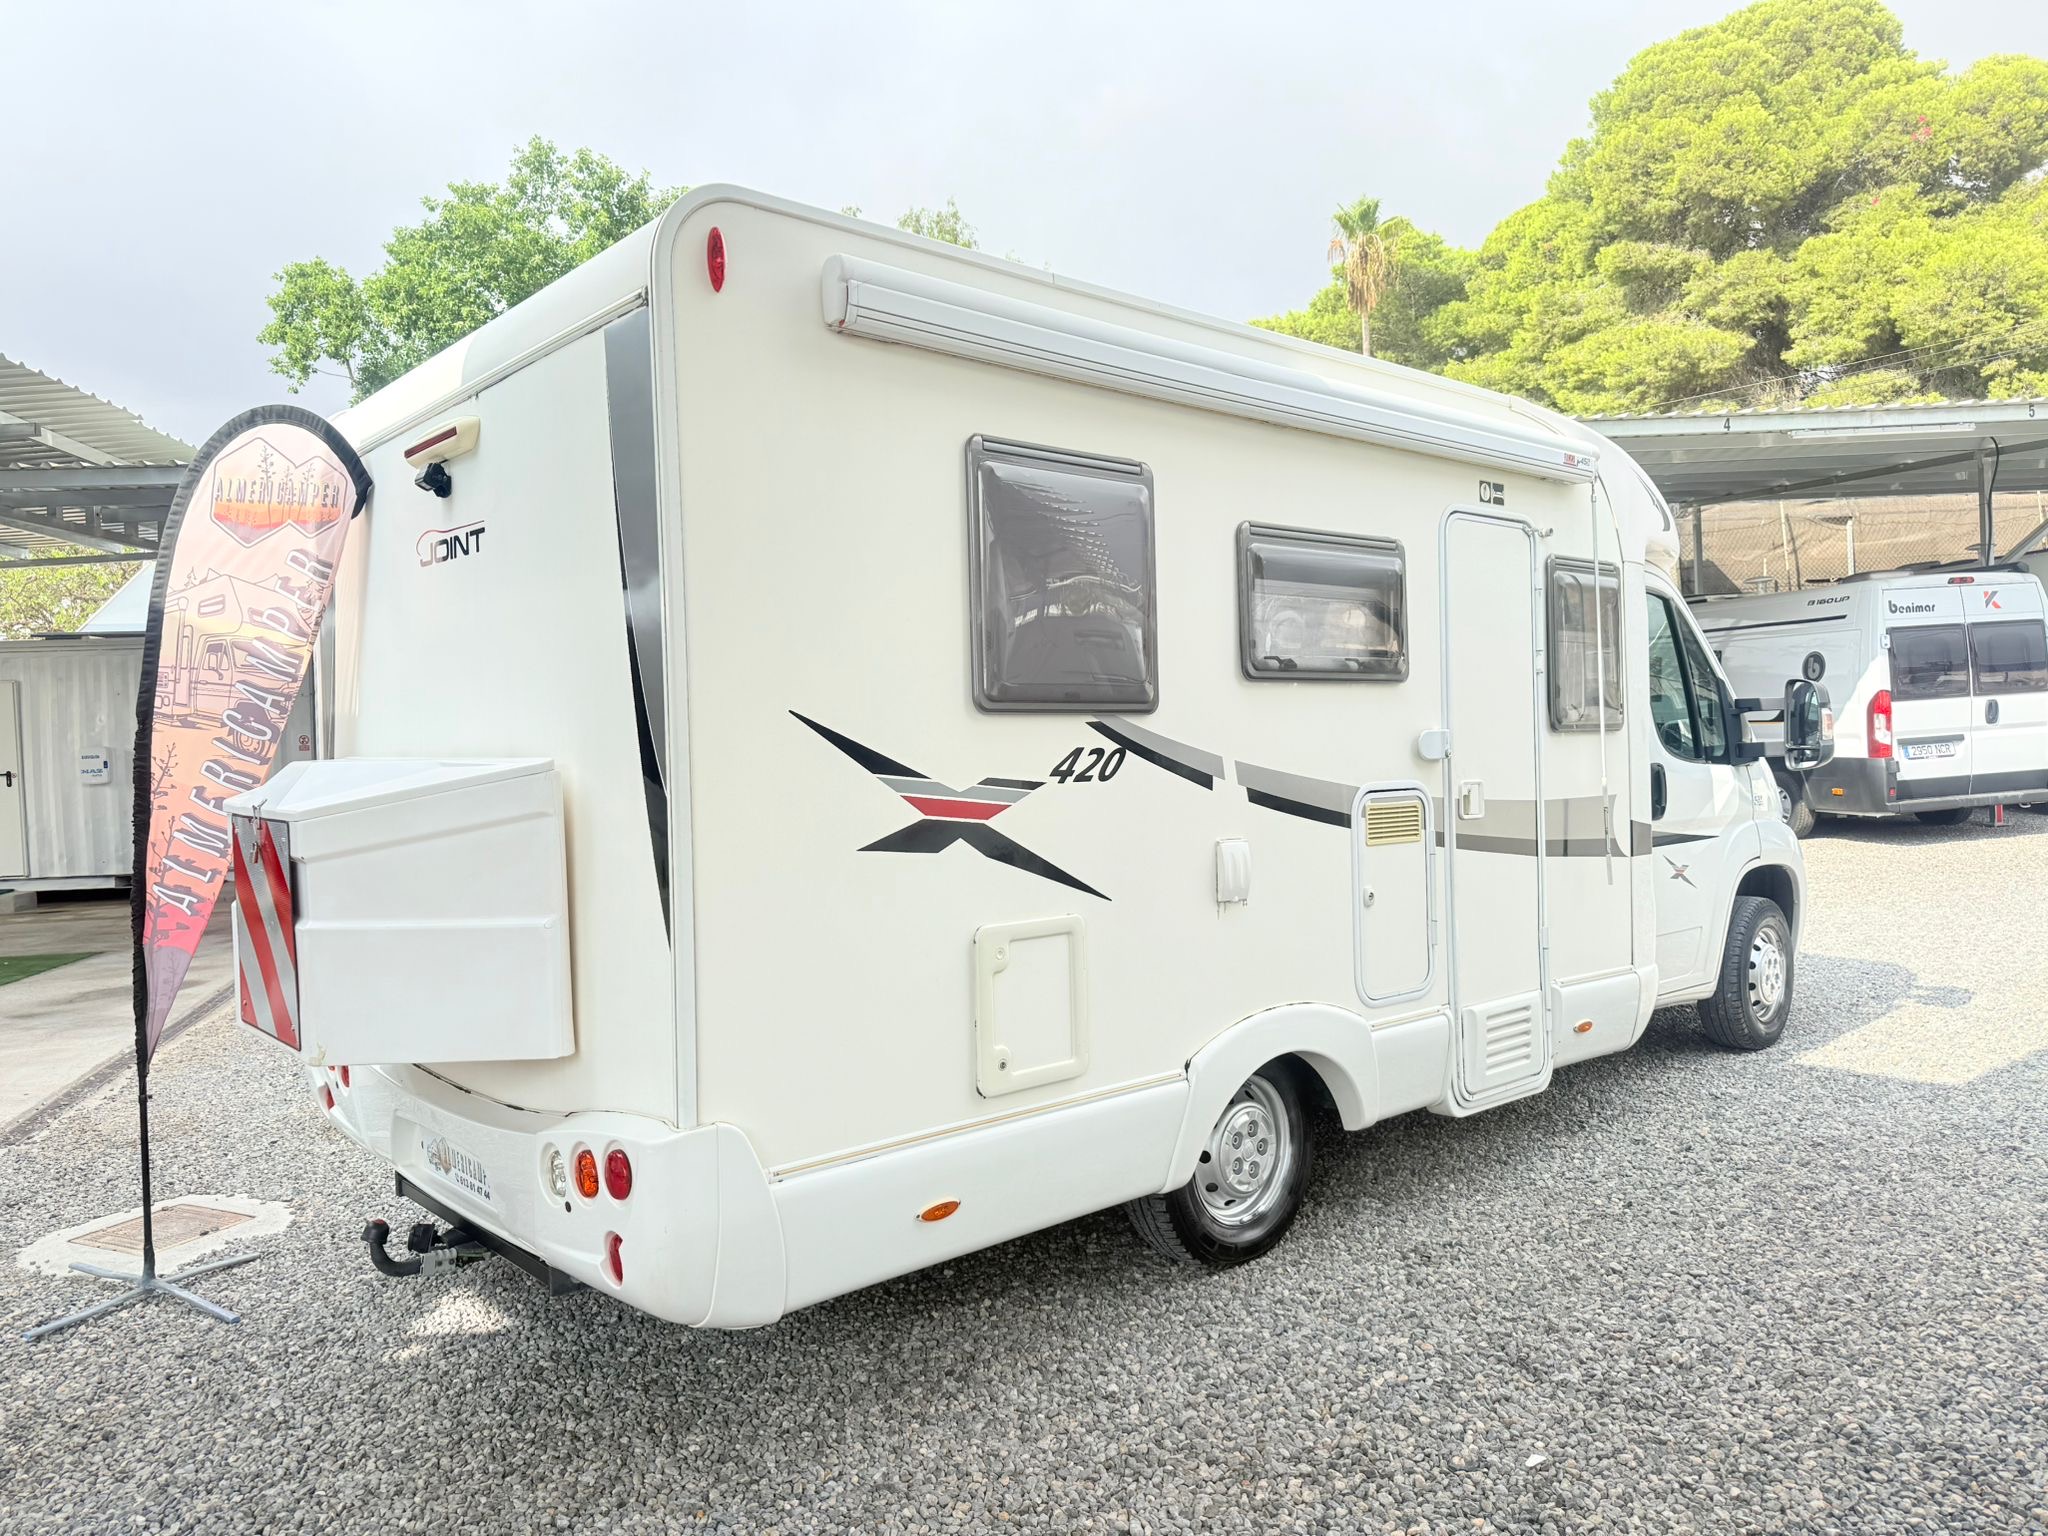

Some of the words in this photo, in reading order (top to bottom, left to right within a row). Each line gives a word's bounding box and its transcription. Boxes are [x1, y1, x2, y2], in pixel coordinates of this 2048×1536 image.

[2028, 405, 2035, 418] 5
[1723, 417, 1731, 431] 4
[419, 526, 486, 567] JOINT
[1887, 599, 1936, 615] benimar
[151, 548, 334, 916] ALMERICAMPER
[1911, 745, 1933, 756] 2950
[1934, 743, 1952, 755] NCR
[1048, 746, 1127, 785] 420
